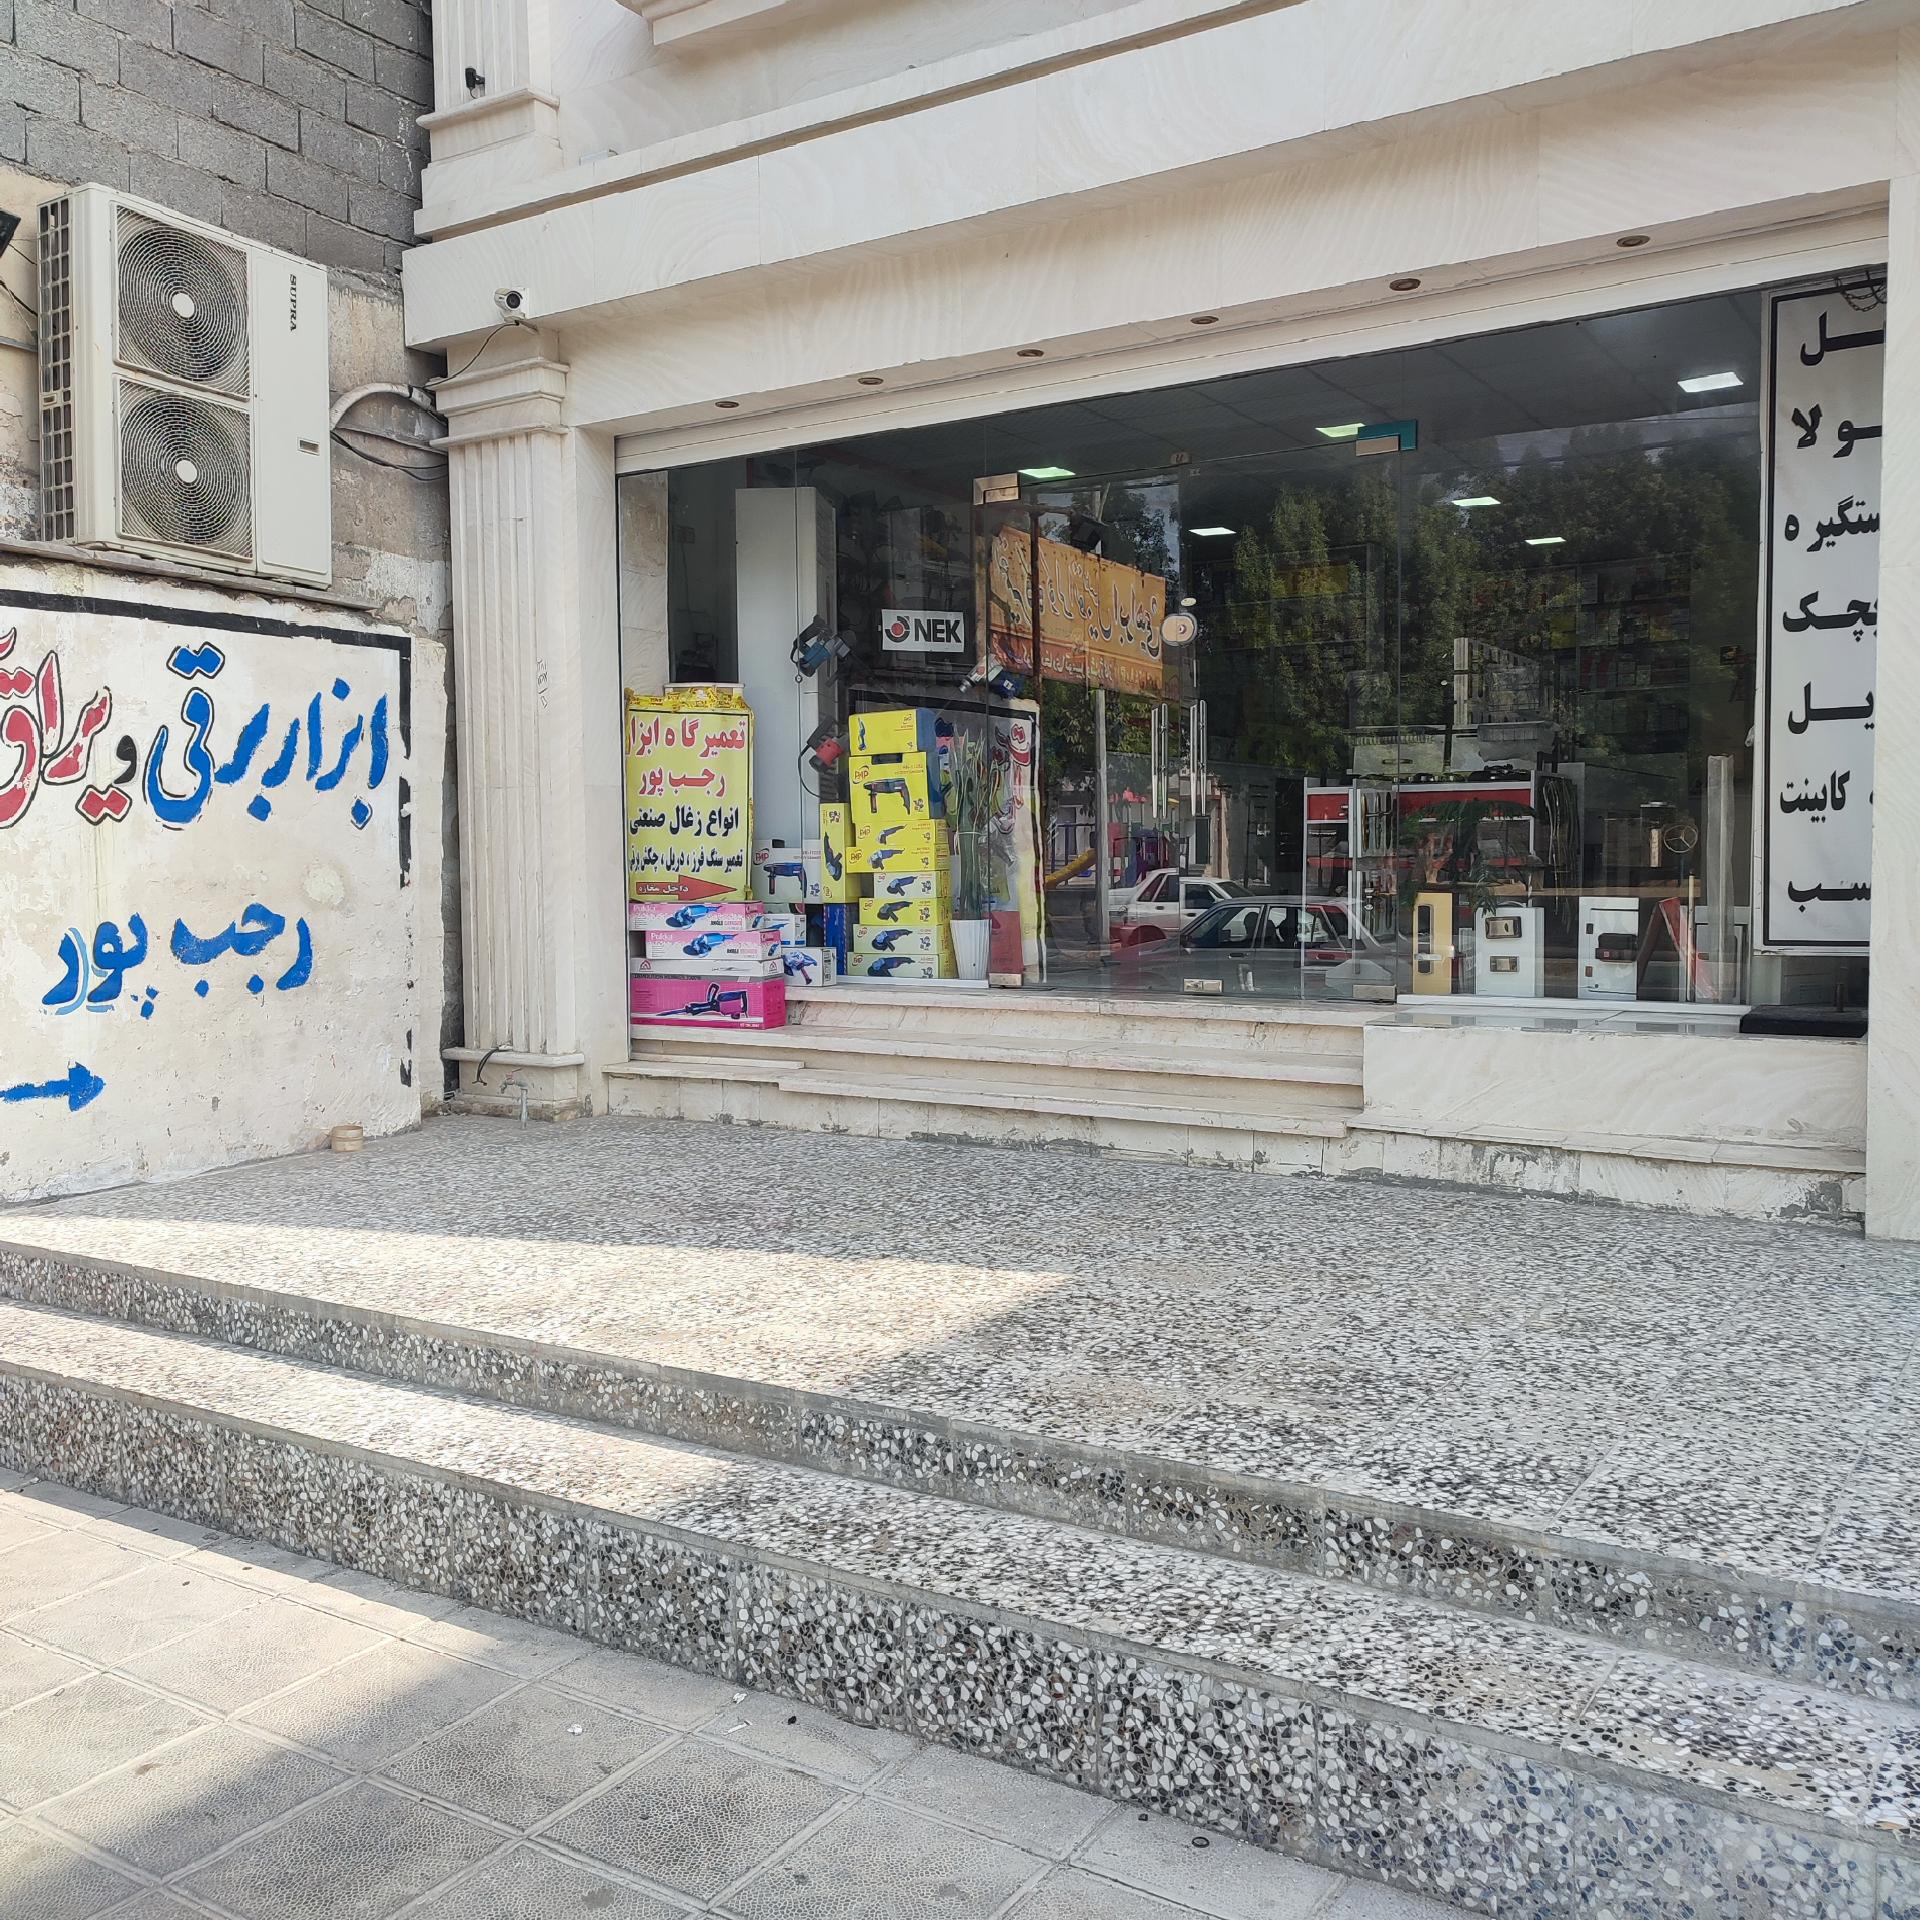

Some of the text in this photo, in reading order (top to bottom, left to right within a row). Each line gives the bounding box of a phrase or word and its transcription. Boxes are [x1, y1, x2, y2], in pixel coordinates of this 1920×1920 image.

[288, 272, 297, 333] SUPRA
[1790, 403, 1883, 459] ولا
[1783, 495, 1880, 553] ستگیره
[914, 618, 963, 643] NEK
[1782, 590, 1879, 643] چک
[1787, 680, 1875, 735] یل
[112, 733, 140, 786] و
[144, 640, 271, 830] برقی
[261, 677, 391, 830] ابزار
[638, 766, 727, 798] رجب پور
[1779, 769, 1851, 824] کابینت
[629, 804, 740, 837] انواع زغال صنعتی
[706, 847, 724, 868] سنگ
[724, 848, 744, 874] تعمیر
[638, 883, 689, 894] داخل مغازه
[1787, 879, 1872, 914] سب
[40, 902, 314, 1020] رجب پور
